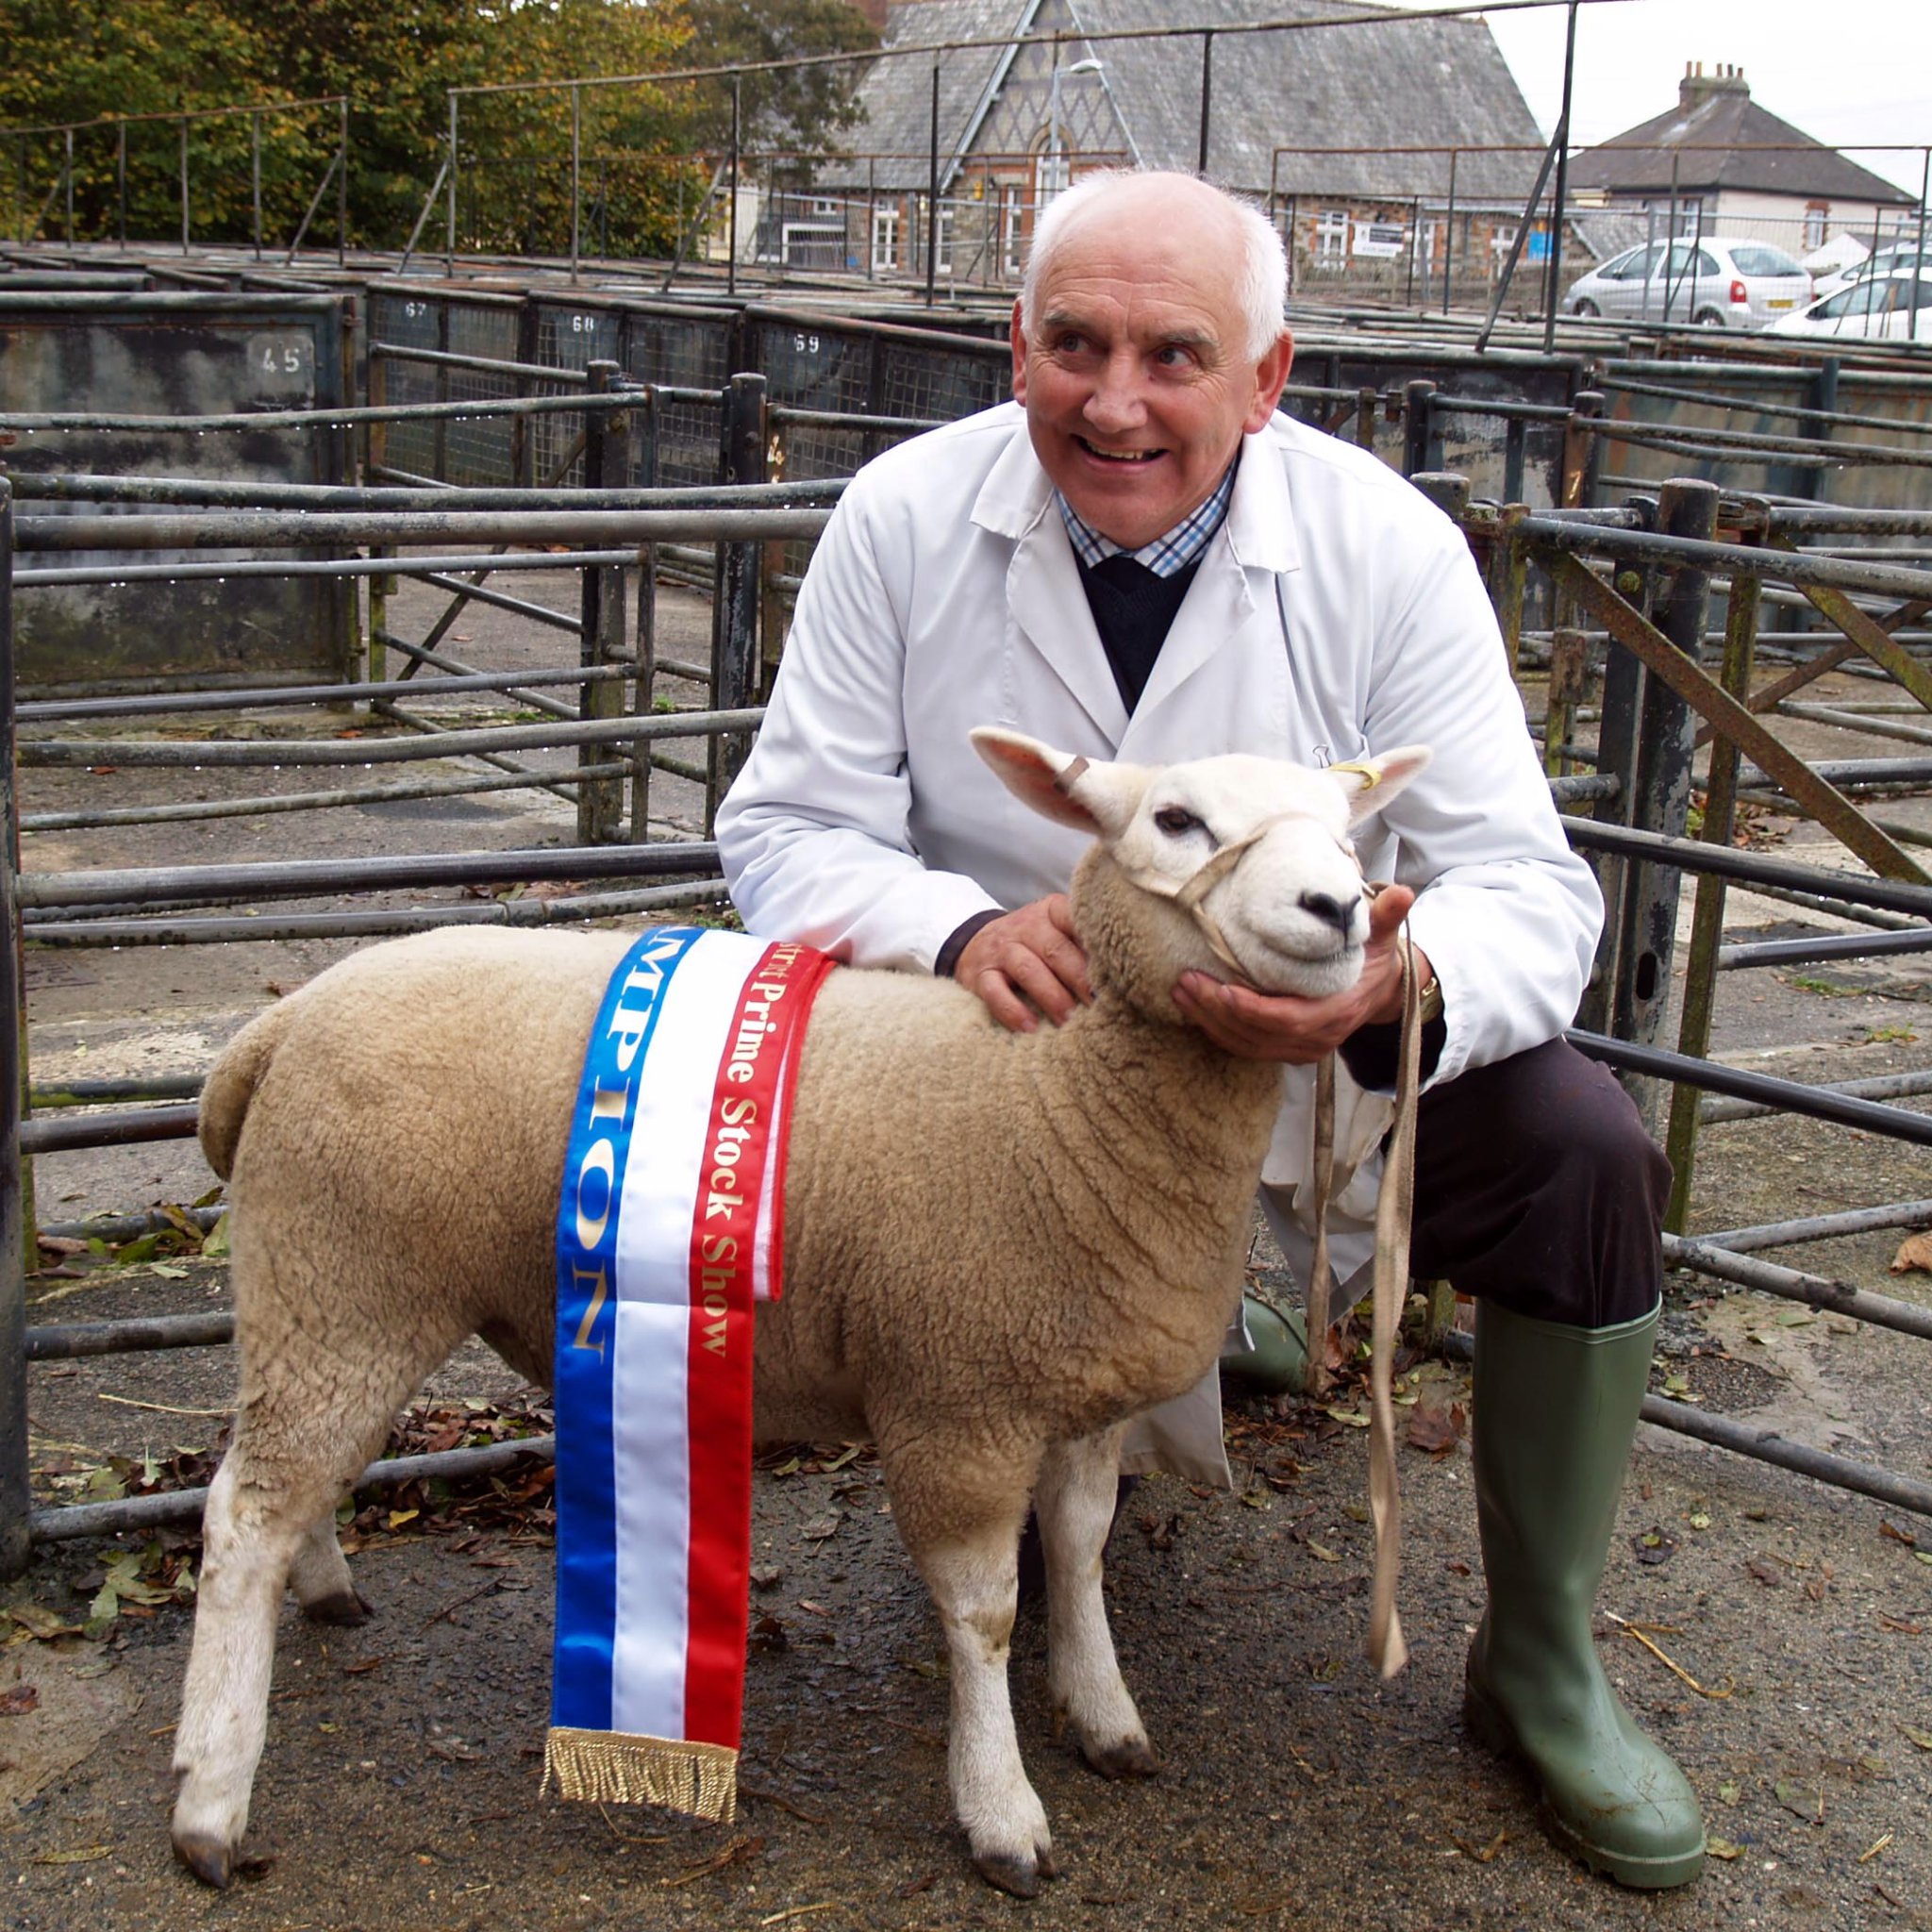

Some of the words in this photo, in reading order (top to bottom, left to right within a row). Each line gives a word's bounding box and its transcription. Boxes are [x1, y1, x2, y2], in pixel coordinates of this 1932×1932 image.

[263, 347, 300, 373] 45
[406, 302, 426, 317] 67
[726, 981, 787, 1083] Prime
[572, 925, 697, 1365] MPION
[705, 1096, 758, 1221] Stock
[701, 1234, 738, 1358] Show
